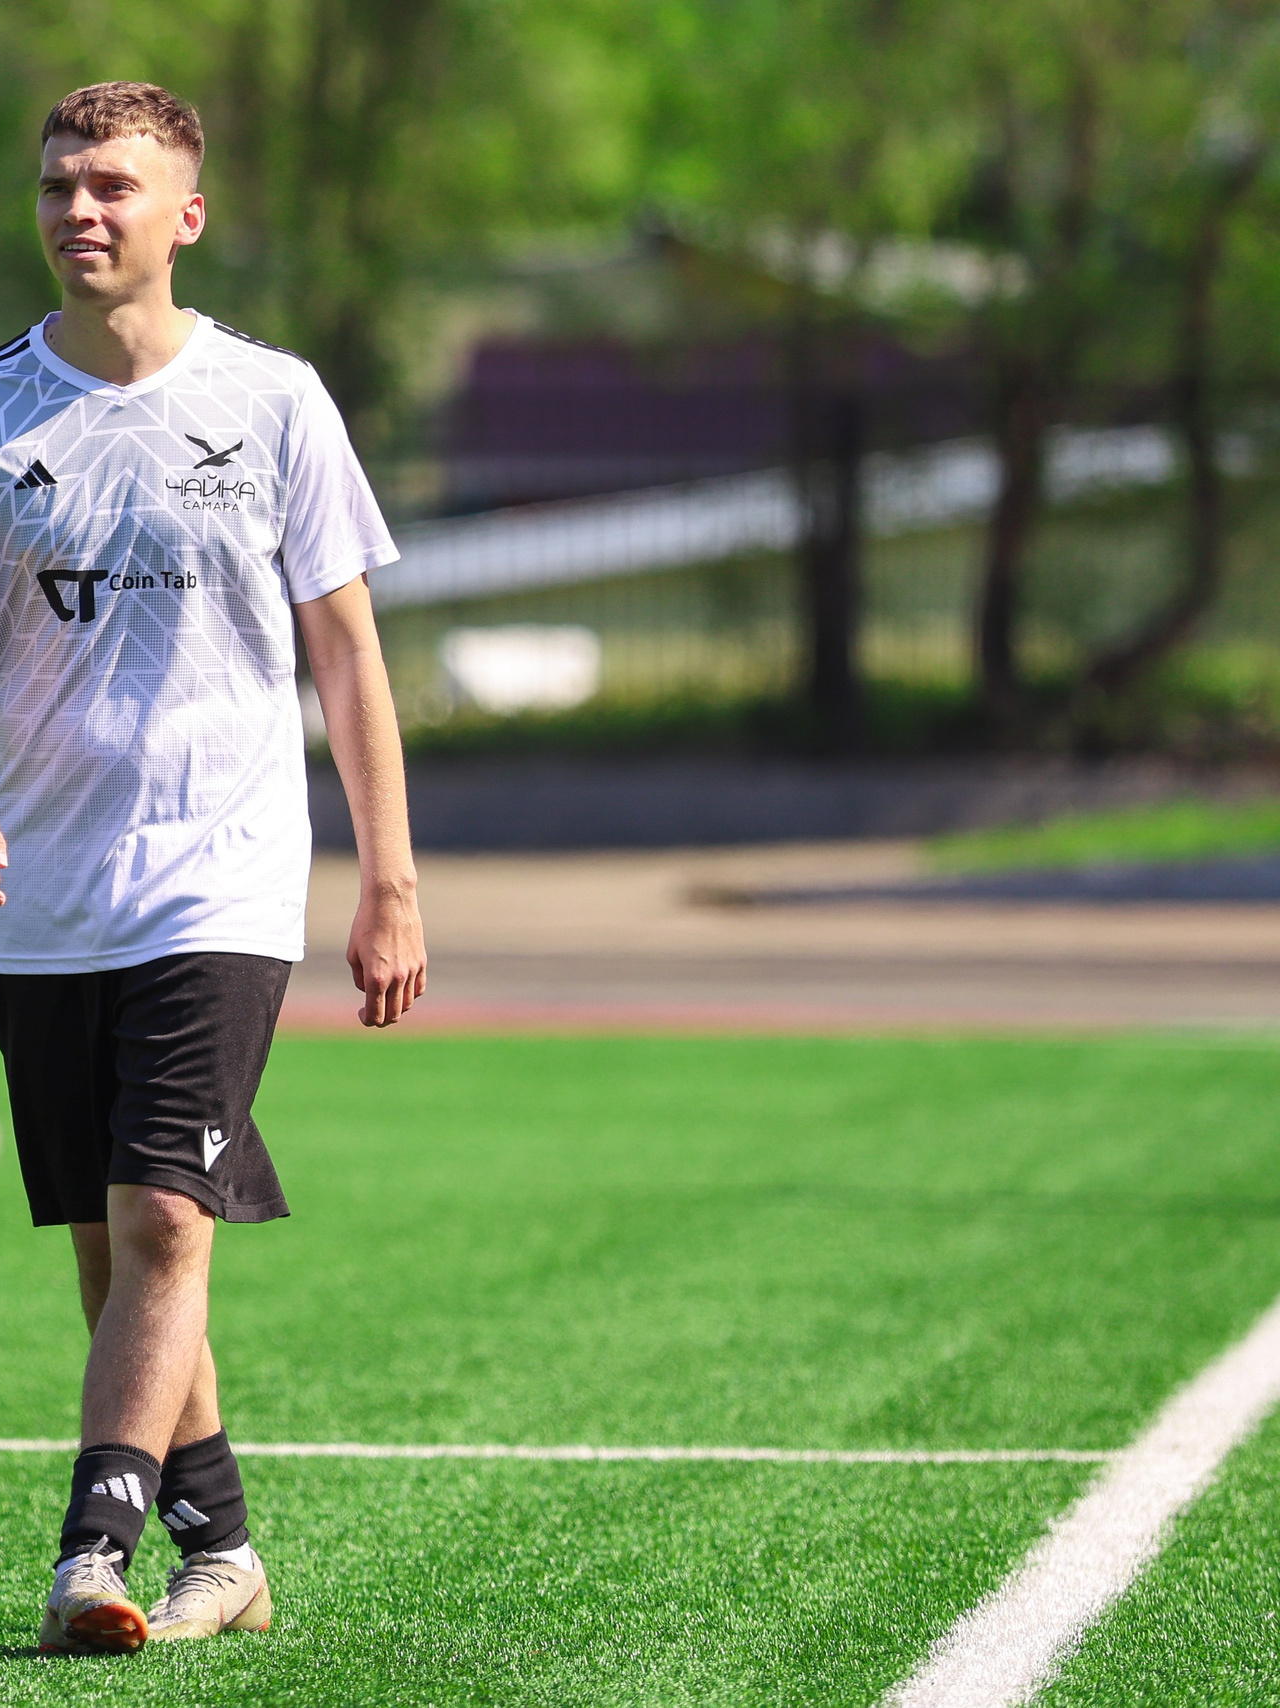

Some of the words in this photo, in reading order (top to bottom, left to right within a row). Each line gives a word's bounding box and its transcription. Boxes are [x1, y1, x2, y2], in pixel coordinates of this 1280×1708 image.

[165, 474, 256, 501] ЧАЙКА
[182, 500, 240, 513] САМАРА
[109, 571, 154, 591] Coin
[160, 571, 197, 589] Tab
